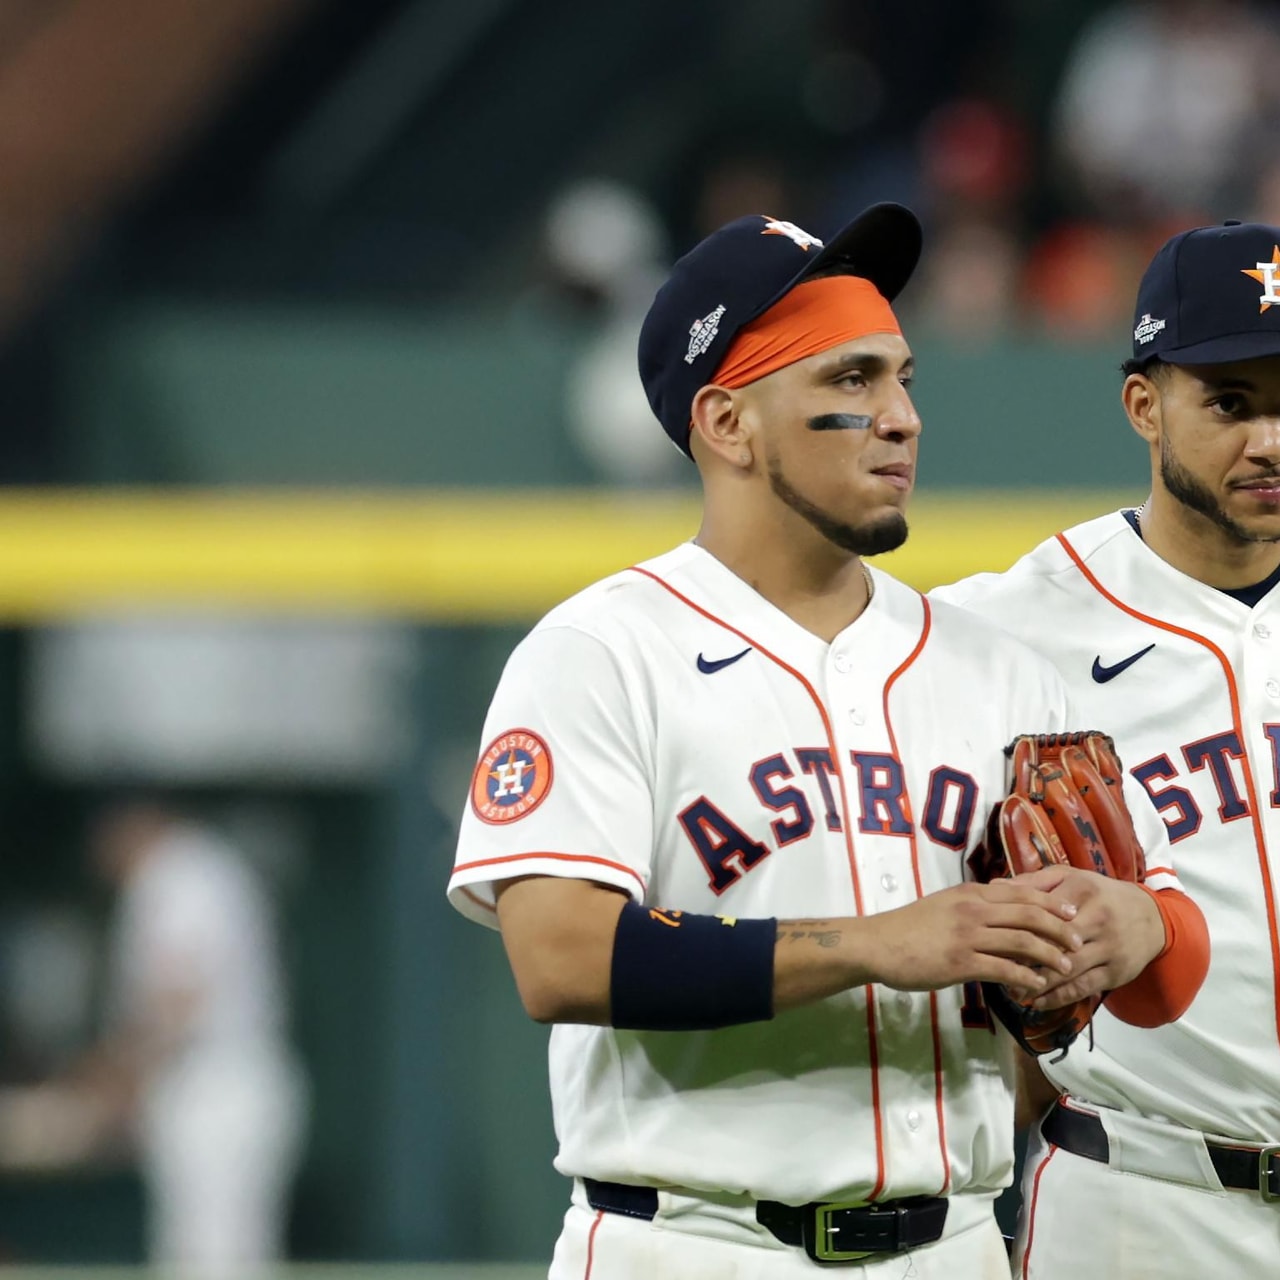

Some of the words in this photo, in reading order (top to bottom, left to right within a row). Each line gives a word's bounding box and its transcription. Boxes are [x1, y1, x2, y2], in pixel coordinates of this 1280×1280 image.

[684, 304, 727, 365] POSTSEASON
[483, 735, 541, 767] HOUSTON
[494, 759, 527, 797] H
[480, 794, 536, 819] ASTROS
[677, 747, 979, 897] ASTRO
